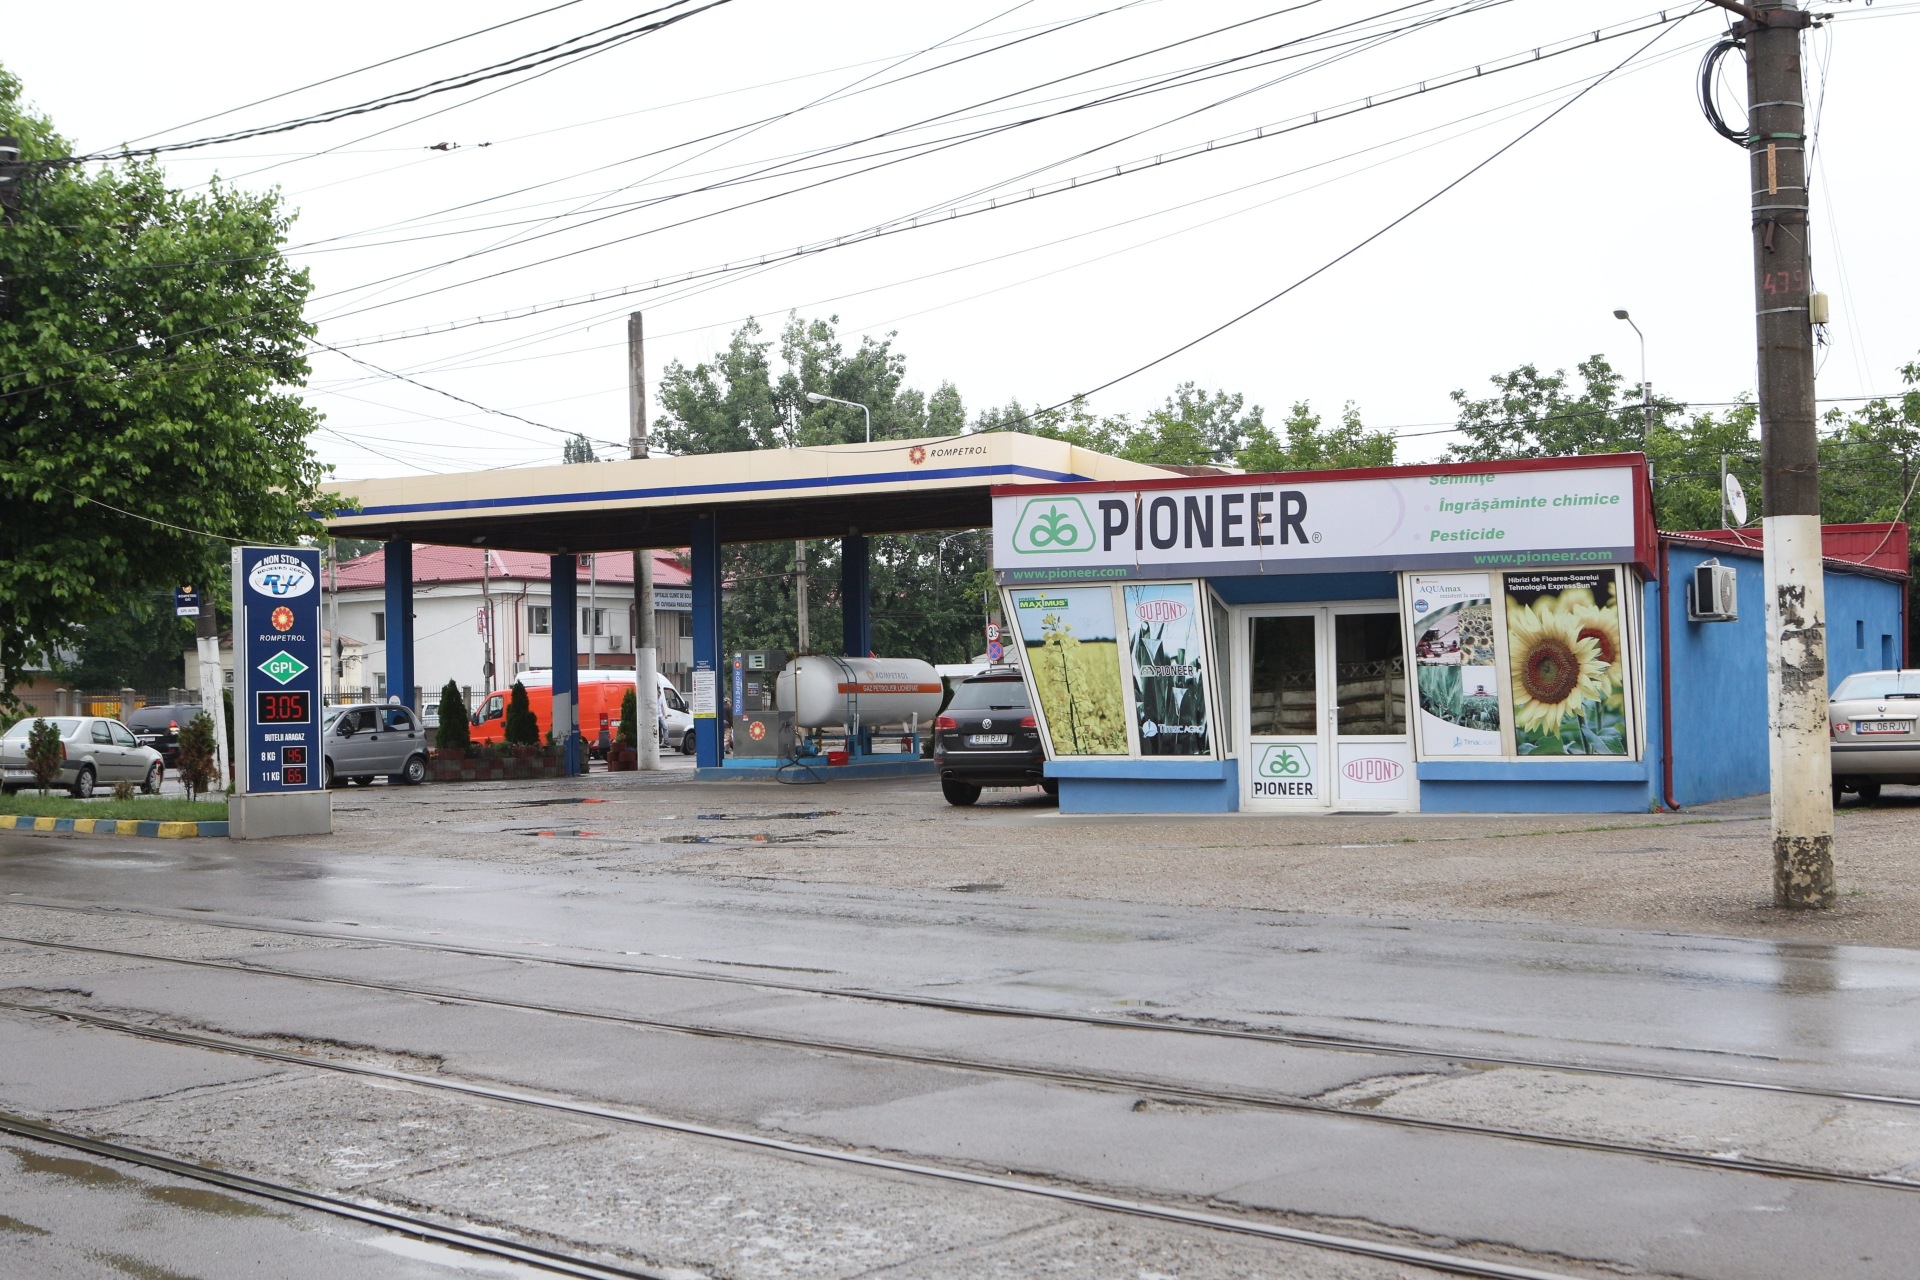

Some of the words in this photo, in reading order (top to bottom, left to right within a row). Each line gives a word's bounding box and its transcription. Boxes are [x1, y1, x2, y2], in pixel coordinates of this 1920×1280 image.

[930, 446, 988, 458] ROMPETROL
[1552, 493, 1620, 507] chimice
[1430, 528, 1505, 542] Pesticide
[263, 555, 280, 565] NON
[281, 554, 300, 565] STOP
[1474, 550, 1613, 565] www.pioneer.com
[1013, 568, 1127, 580] www.pioneer.com
[1541, 574, 1600, 583] Floarea-Soarelui
[1420, 586, 1461, 594] AQUAmax
[1508, 584, 1547, 592] Tehnologia
[1140, 605, 1154, 620] DU
[1155, 602, 1183, 621] PONT
[270, 662, 296, 674] GPL
[1154, 665, 1194, 677] PIONEER
[875, 672, 909, 680] ROMPETROL
[265, 695, 303, 719] 3.05
[1862, 723, 1873, 731] GL
[1877, 723, 1888, 731] 06
[1889, 722, 1907, 730] RJV
[285, 733, 305, 741] ARAGAZ
[261, 752, 267, 761] 8
[267, 752, 276, 761] KG
[287, 749, 302, 762] 45
[262, 772, 270, 781] 11
[271, 771, 280, 781] KG
[1347, 762, 1364, 778] DU
[1366, 760, 1399, 781] PONT
[1254, 782, 1313, 796] PIONEER
